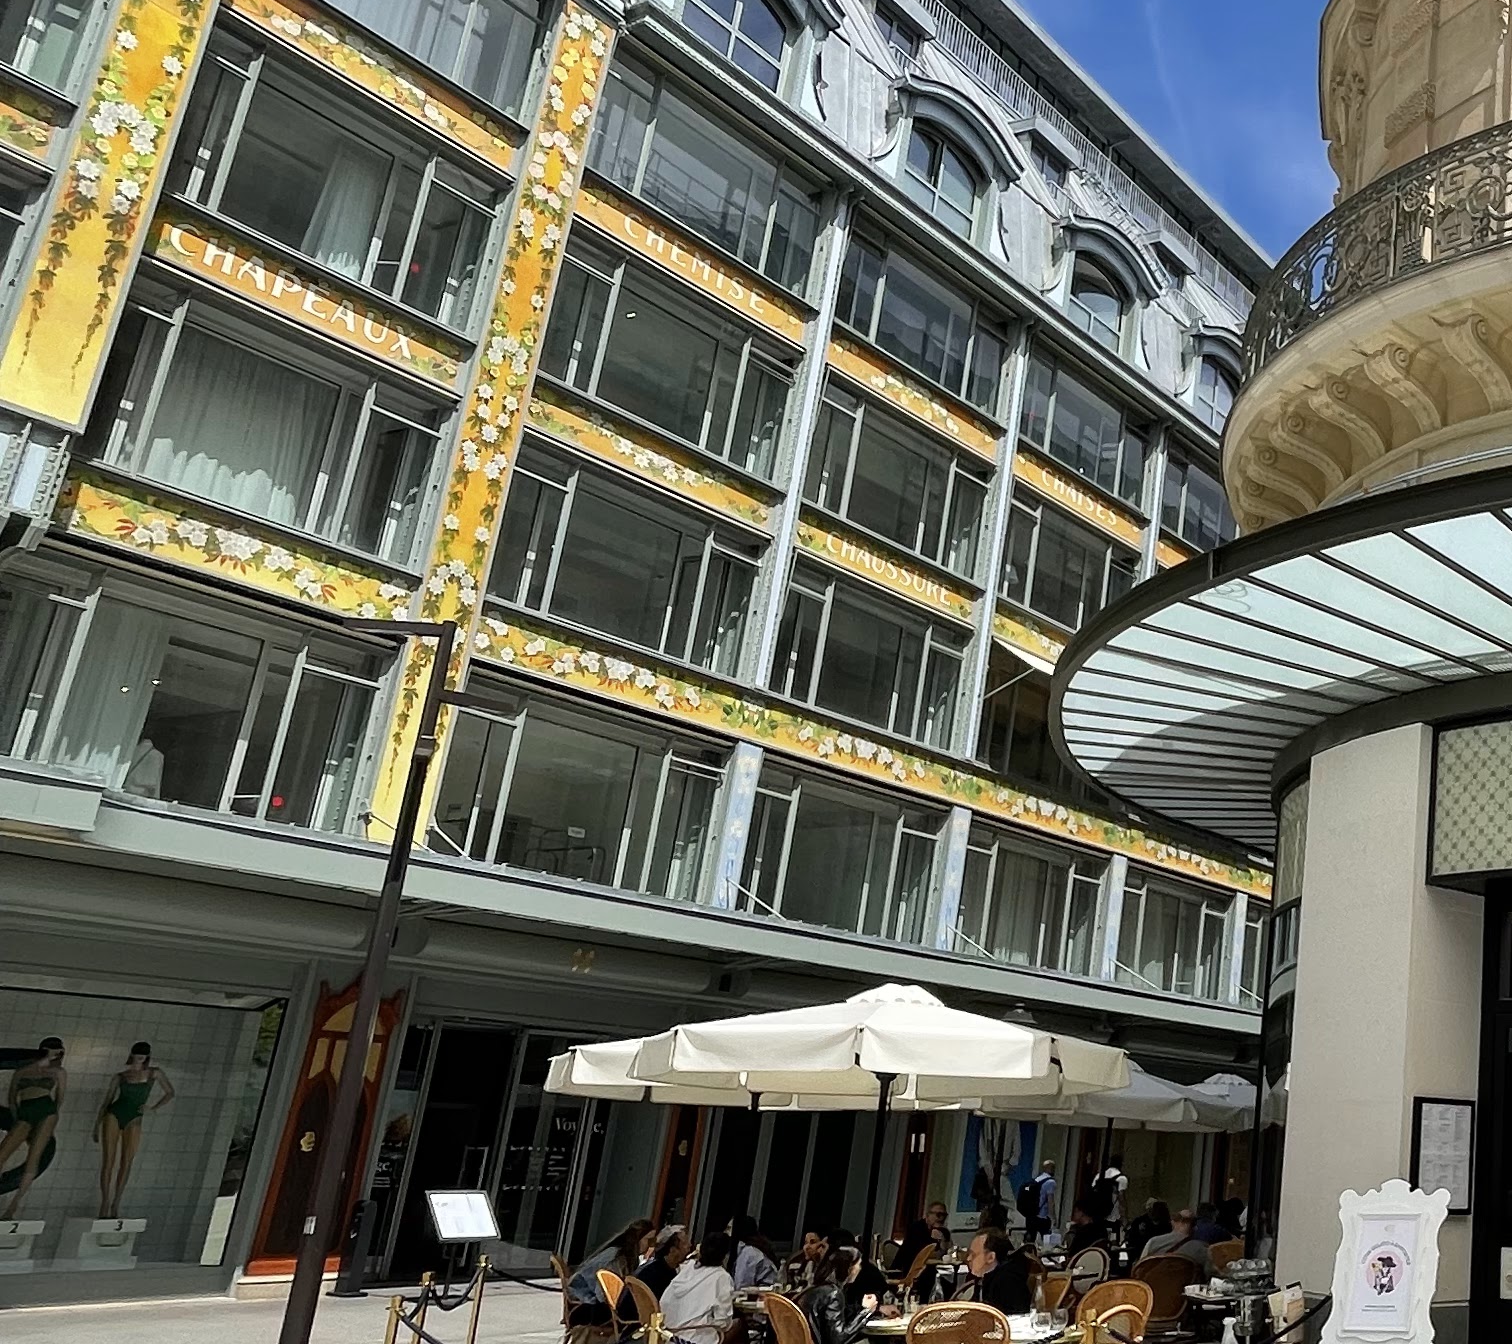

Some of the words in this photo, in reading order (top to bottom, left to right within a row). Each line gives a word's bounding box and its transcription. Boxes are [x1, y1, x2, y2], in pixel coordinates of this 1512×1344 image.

[169, 222, 420, 360] CHAPEAUX
[622, 212, 767, 315] CHEMISE
[1041, 467, 1118, 526] CHAISES
[825, 530, 955, 607] CHAUSSURE
[8, 1222, 19, 1234] 2
[113, 1220, 124, 1232] 3
